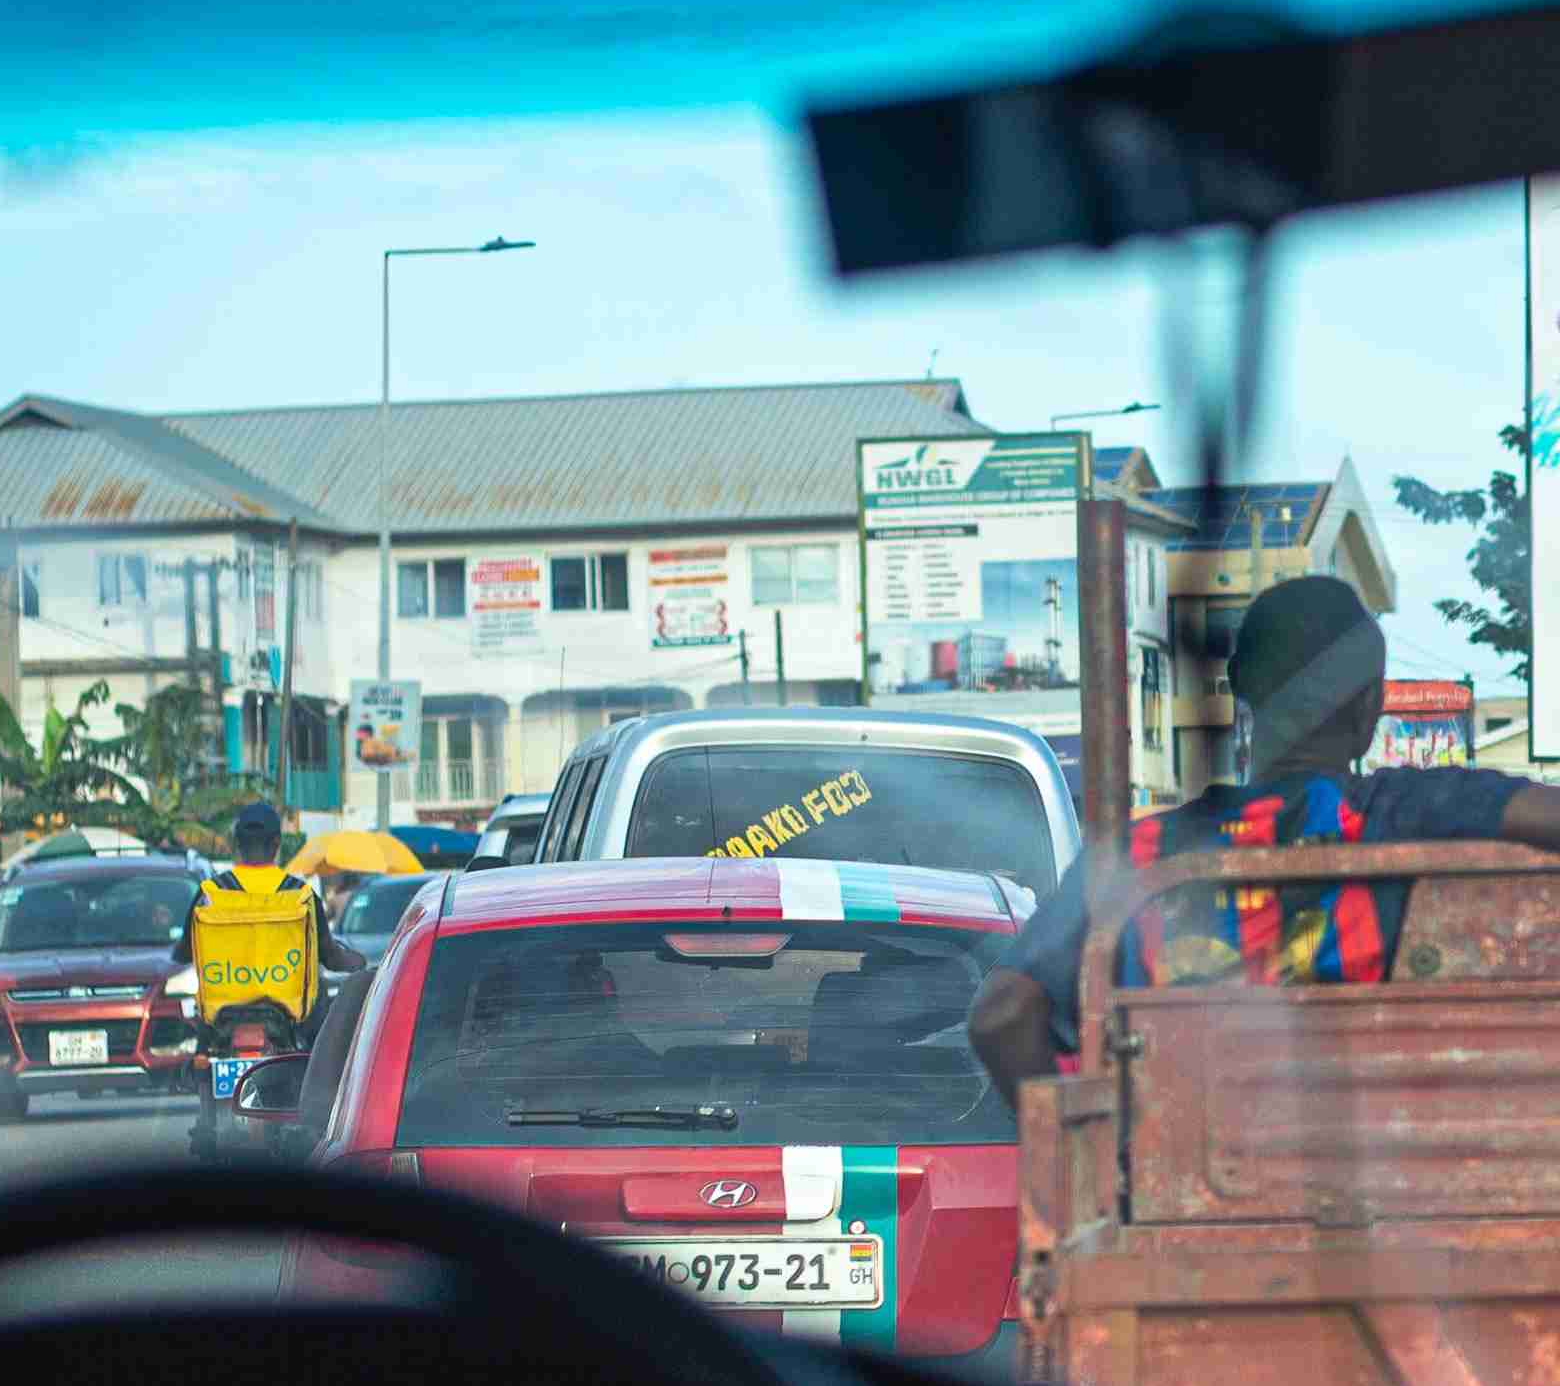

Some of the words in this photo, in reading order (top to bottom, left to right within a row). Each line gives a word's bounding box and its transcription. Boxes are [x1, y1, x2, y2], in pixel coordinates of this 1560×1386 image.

[203, 960, 289, 984] Glovo
[690, 1253, 831, 1291] 973-21
[848, 1268, 874, 1285] GH
